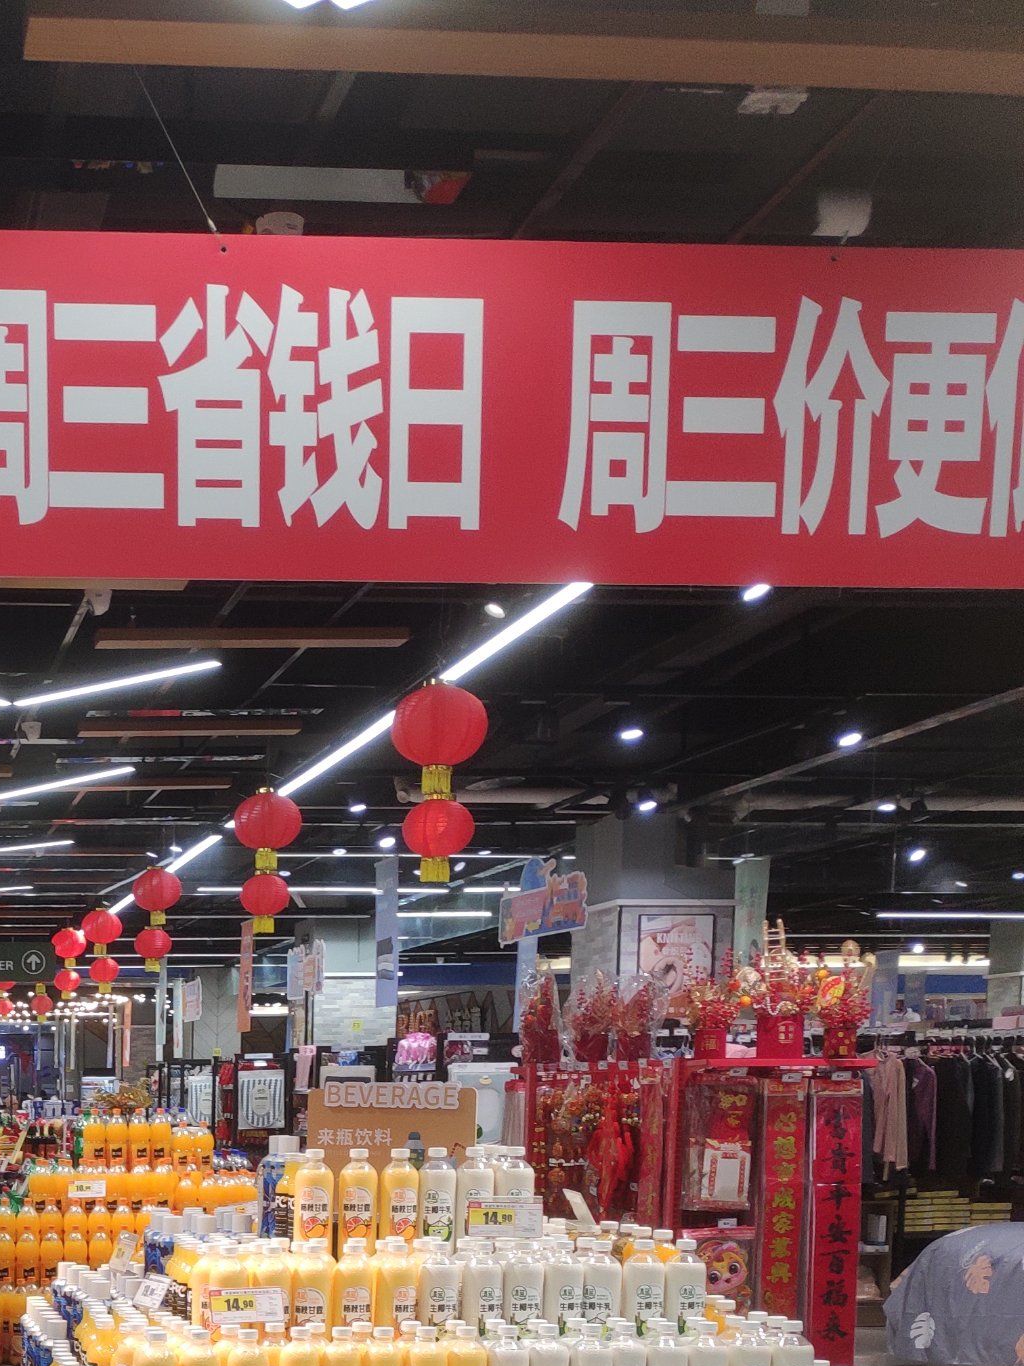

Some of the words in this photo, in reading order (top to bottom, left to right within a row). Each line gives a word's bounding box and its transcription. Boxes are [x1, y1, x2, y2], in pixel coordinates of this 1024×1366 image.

[326, 1084, 458, 1107] BEVERAGE
[318, 1128, 392, 1146] 来瓶饮料
[482, 1211, 513, 1225] 14.90
[224, 1298, 254, 1312] 14.90
